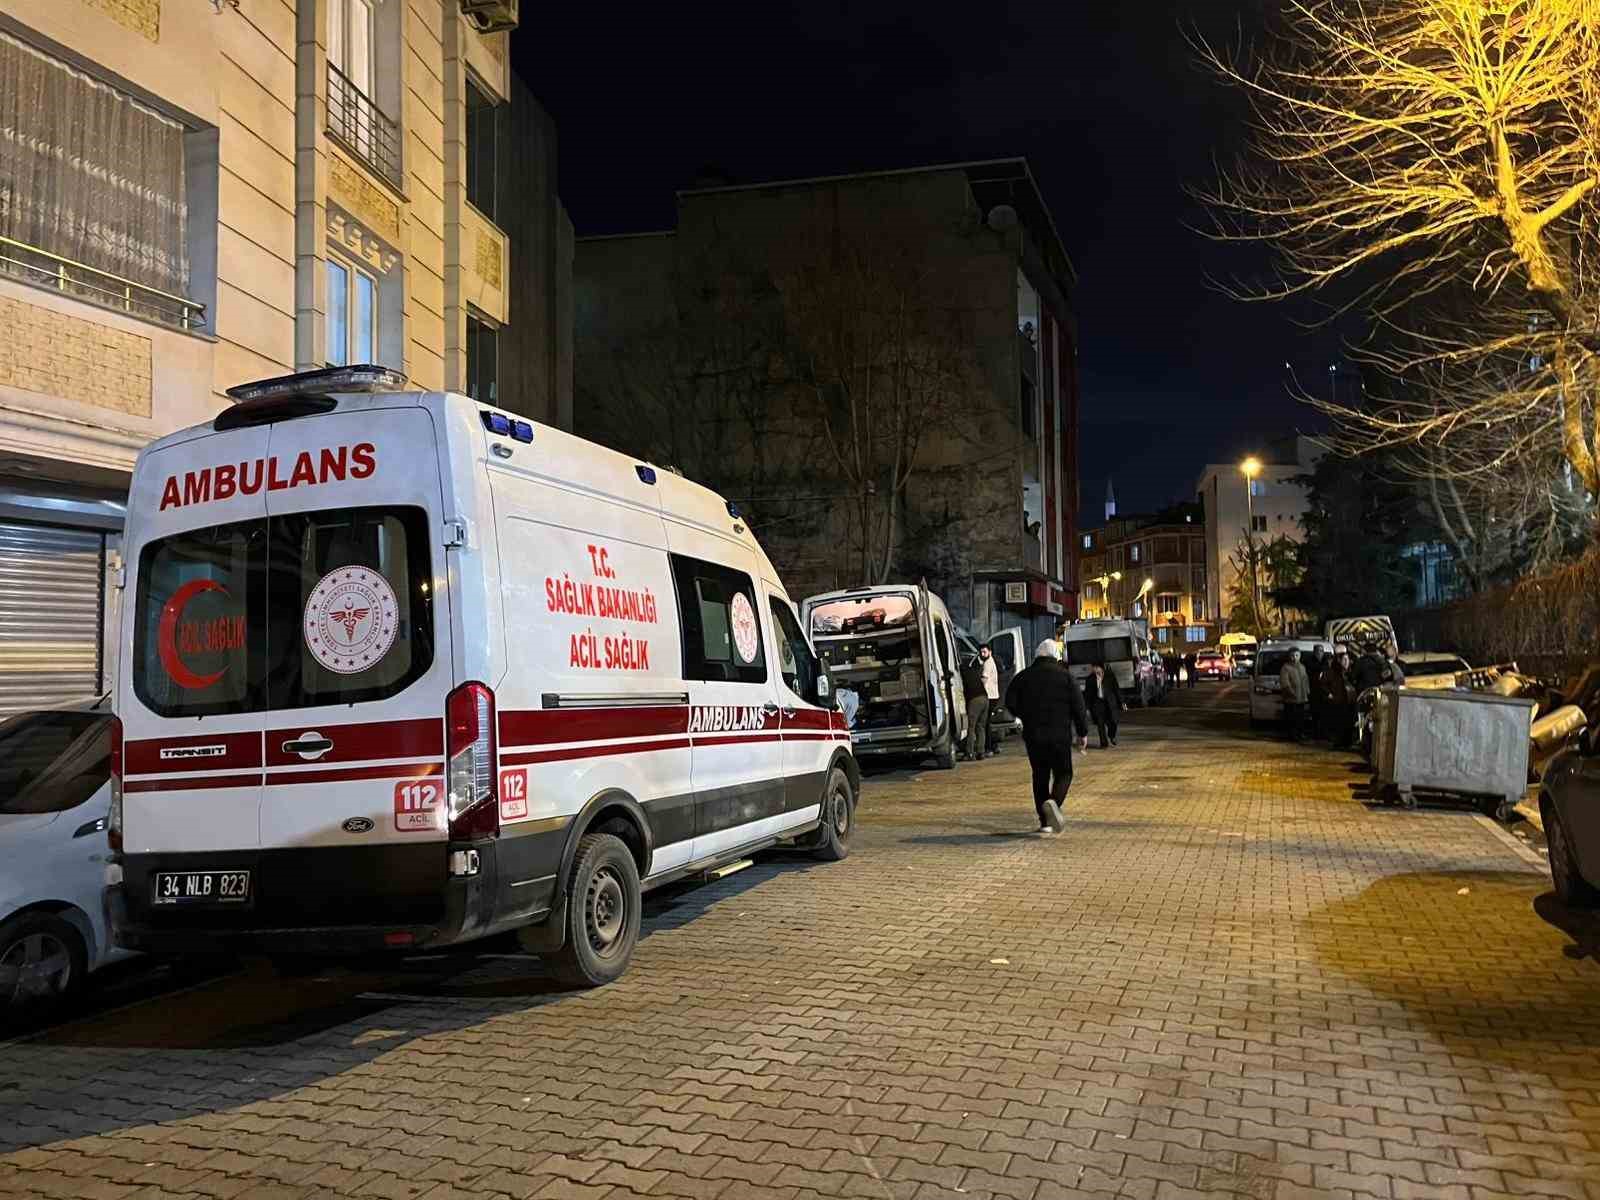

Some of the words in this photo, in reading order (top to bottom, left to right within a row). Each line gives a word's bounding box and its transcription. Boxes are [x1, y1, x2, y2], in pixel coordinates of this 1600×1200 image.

[159, 442, 377, 512] AMBULANS
[587, 543, 616, 579] T.C.
[545, 573, 595, 617] SAĞLIK
[596, 586, 658, 624] BAKANLIĞI
[569, 628, 601, 671] ACİL
[604, 632, 649, 671] SAĞLIK
[690, 705, 766, 733] AMBULANS
[162, 746, 225, 758] TRANSIT
[401, 784, 438, 810] 112
[503, 774, 524, 799] 112
[408, 814, 430, 824] ACİL
[163, 875, 180, 896] 34
[185, 875, 212, 896] NLB
[219, 874, 247, 896] 823
